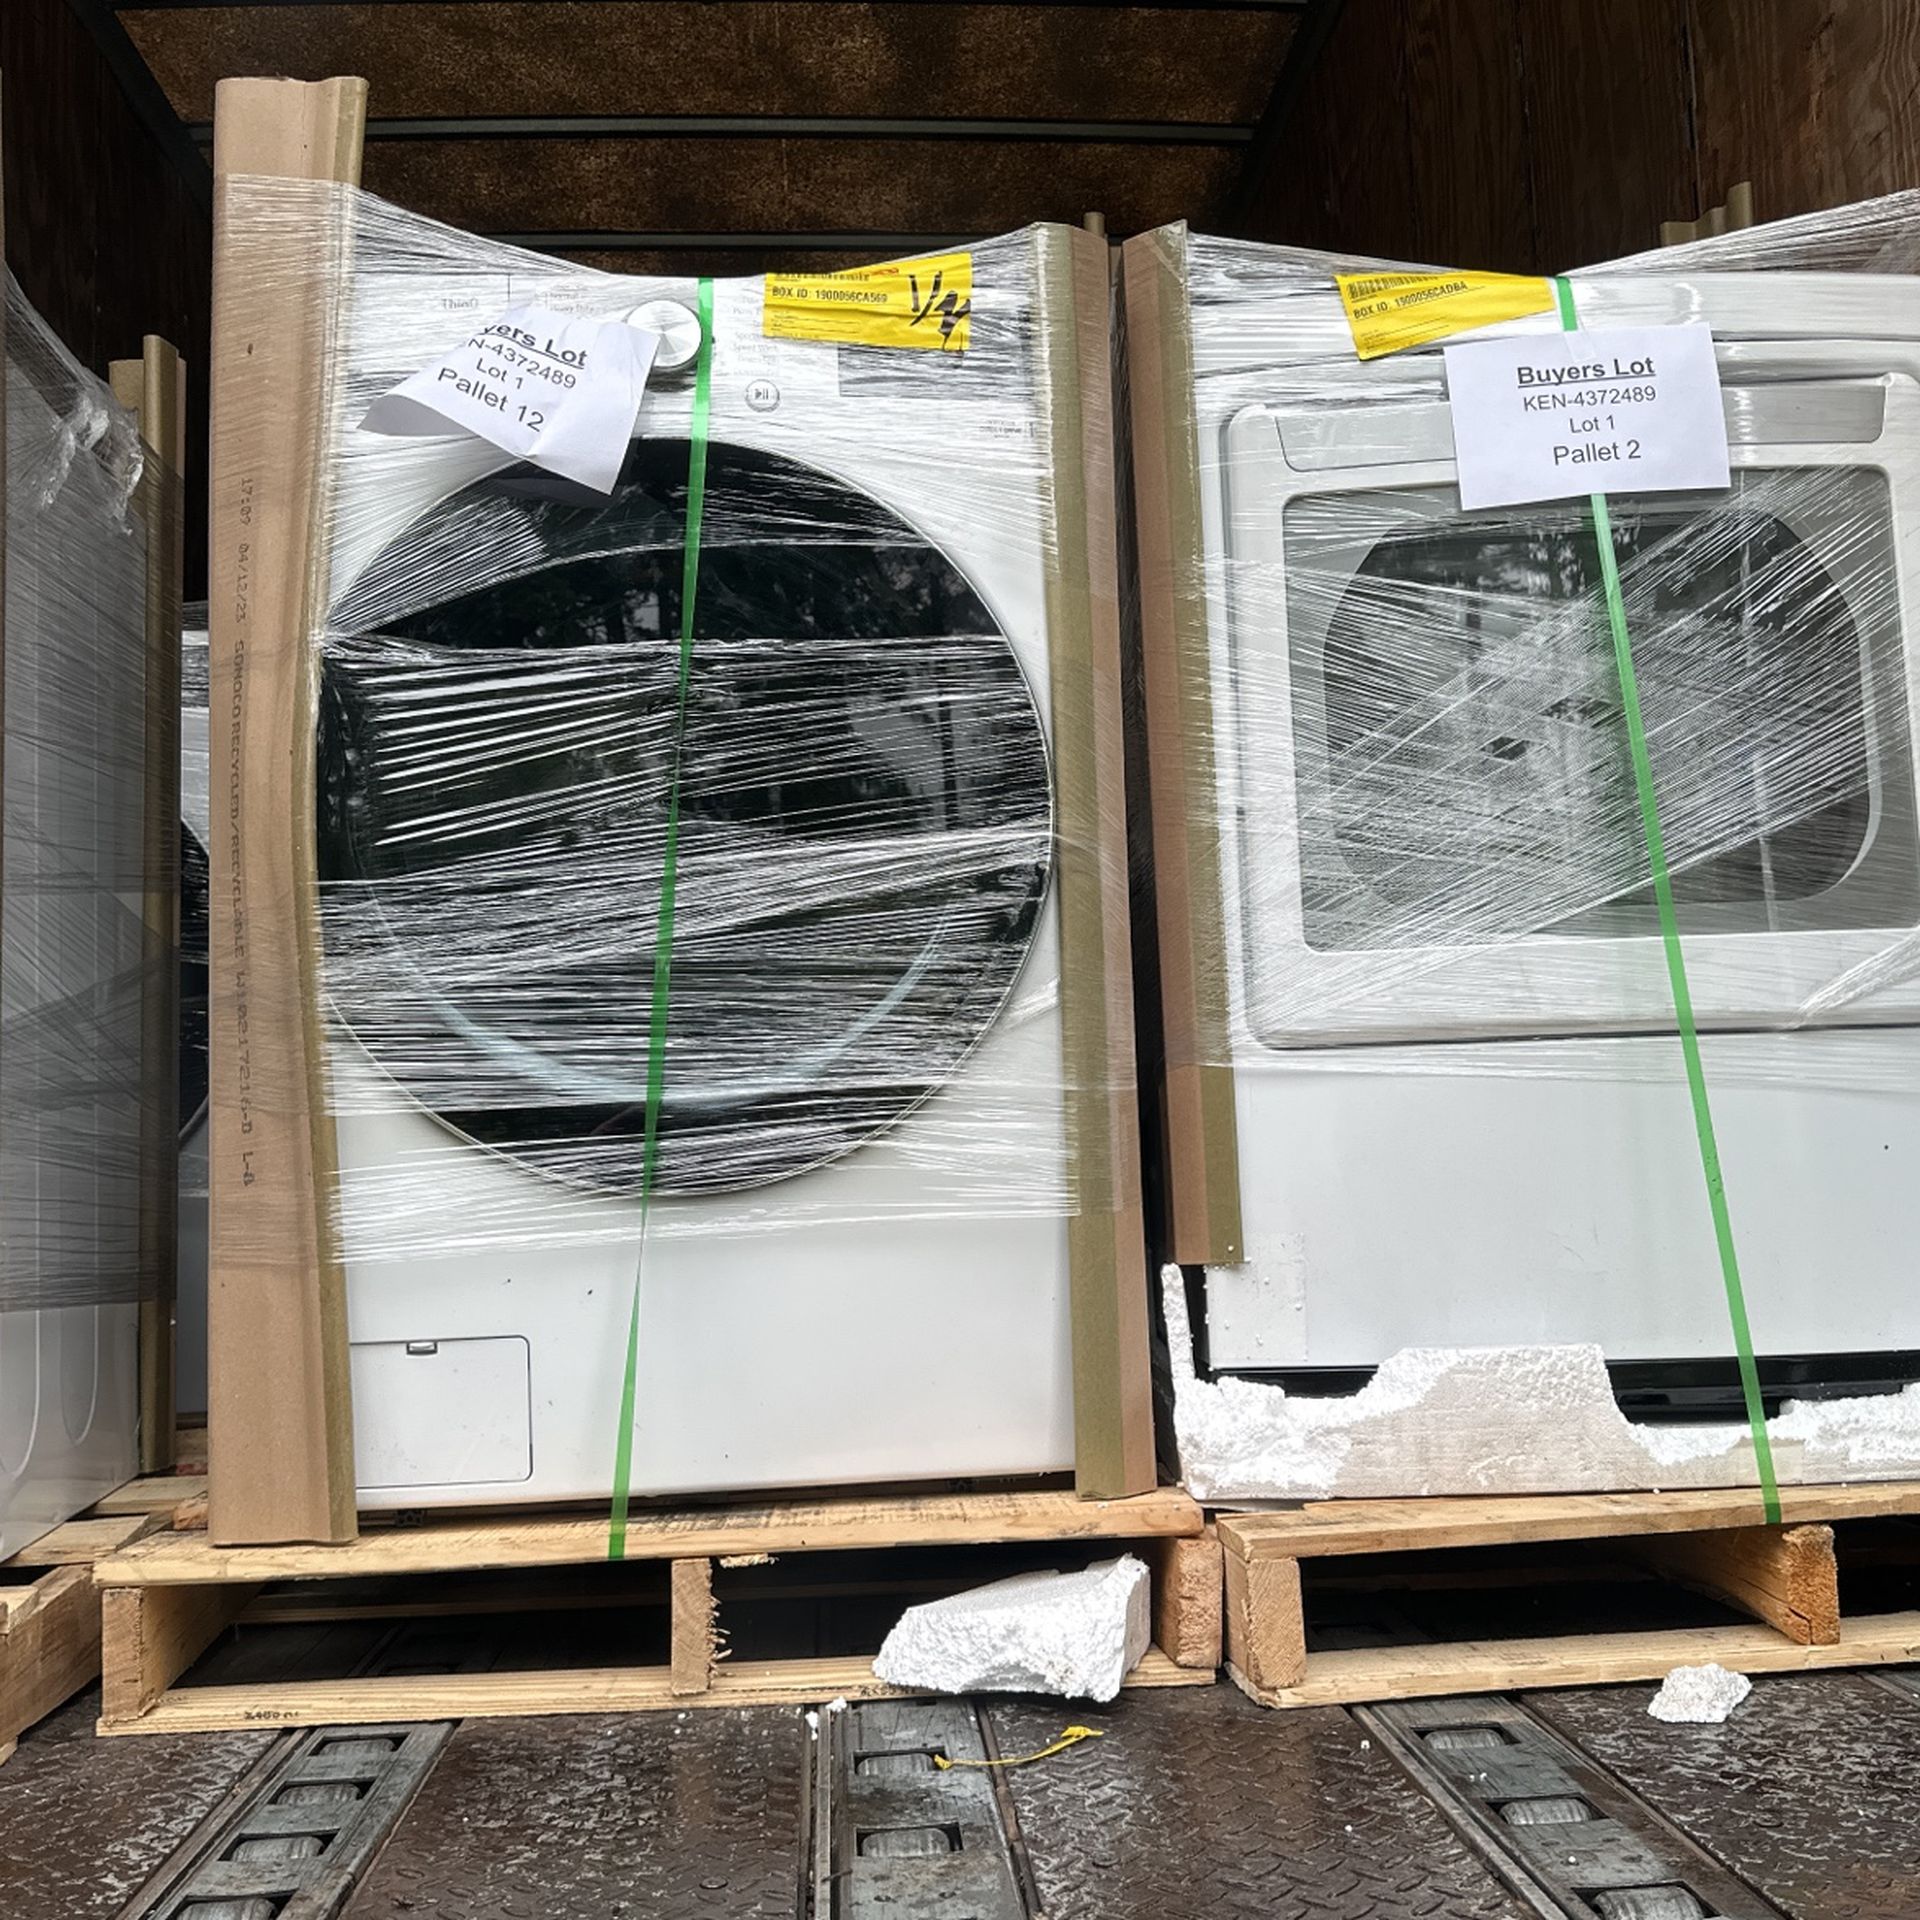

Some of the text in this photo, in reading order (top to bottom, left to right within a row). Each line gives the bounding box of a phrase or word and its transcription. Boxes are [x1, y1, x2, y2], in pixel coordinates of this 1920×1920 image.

[772, 285, 793, 297] BOX
[1353, 303, 1374, 319] BOX
[545, 338, 588, 367] Lot
[476, 357, 524, 390] Lot 1
[1517, 356, 1655, 387] Buyers Lot
[437, 367, 545, 433] Pallet 12
[1523, 384, 1656, 412] KEN-4372489
[1569, 414, 1614, 433] Lot 1
[1553, 438, 1641, 466] Pallet 2
[231, 639, 246, 718] SONOCO
